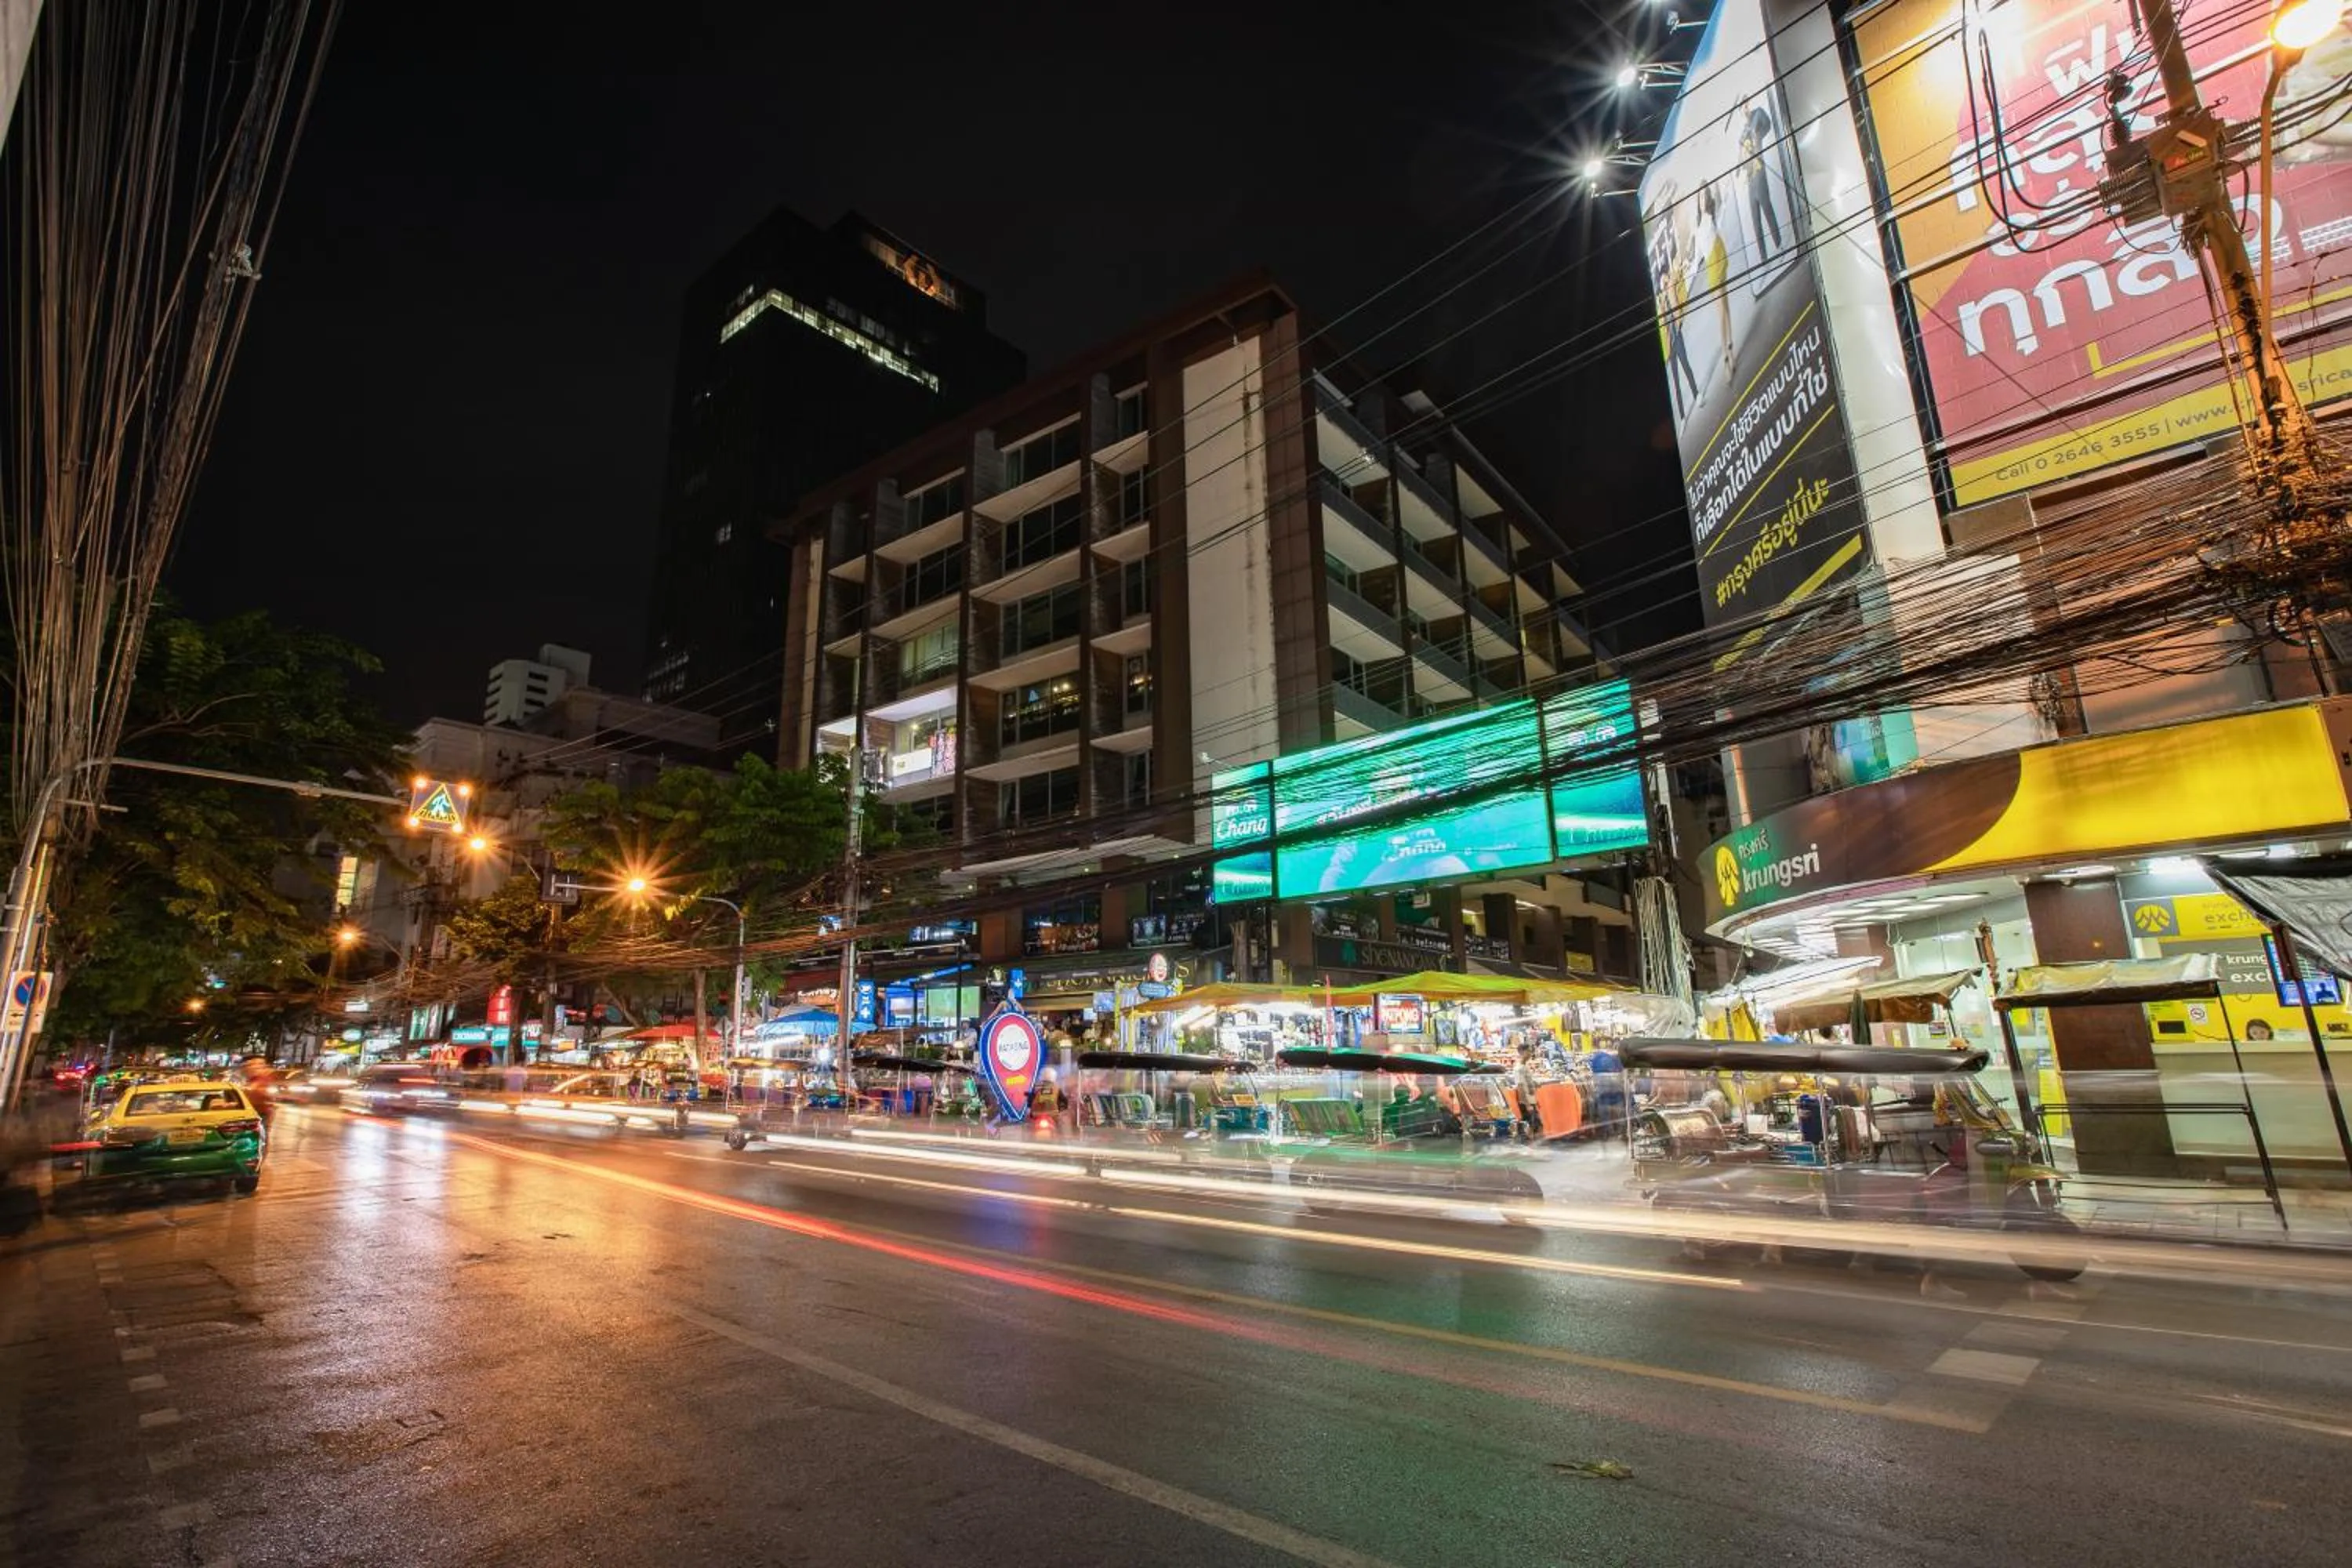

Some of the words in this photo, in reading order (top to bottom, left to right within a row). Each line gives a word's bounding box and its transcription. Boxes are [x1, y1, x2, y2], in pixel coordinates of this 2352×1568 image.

[1995, 463, 2030, 481] Call
[2035, 458, 2048, 470] 0
[2054, 441, 2103, 464] 2646
[2111, 423, 2160, 448] 3555
[1216, 818, 1268, 840] Chang
[1742, 843, 1820, 893] krungsri
